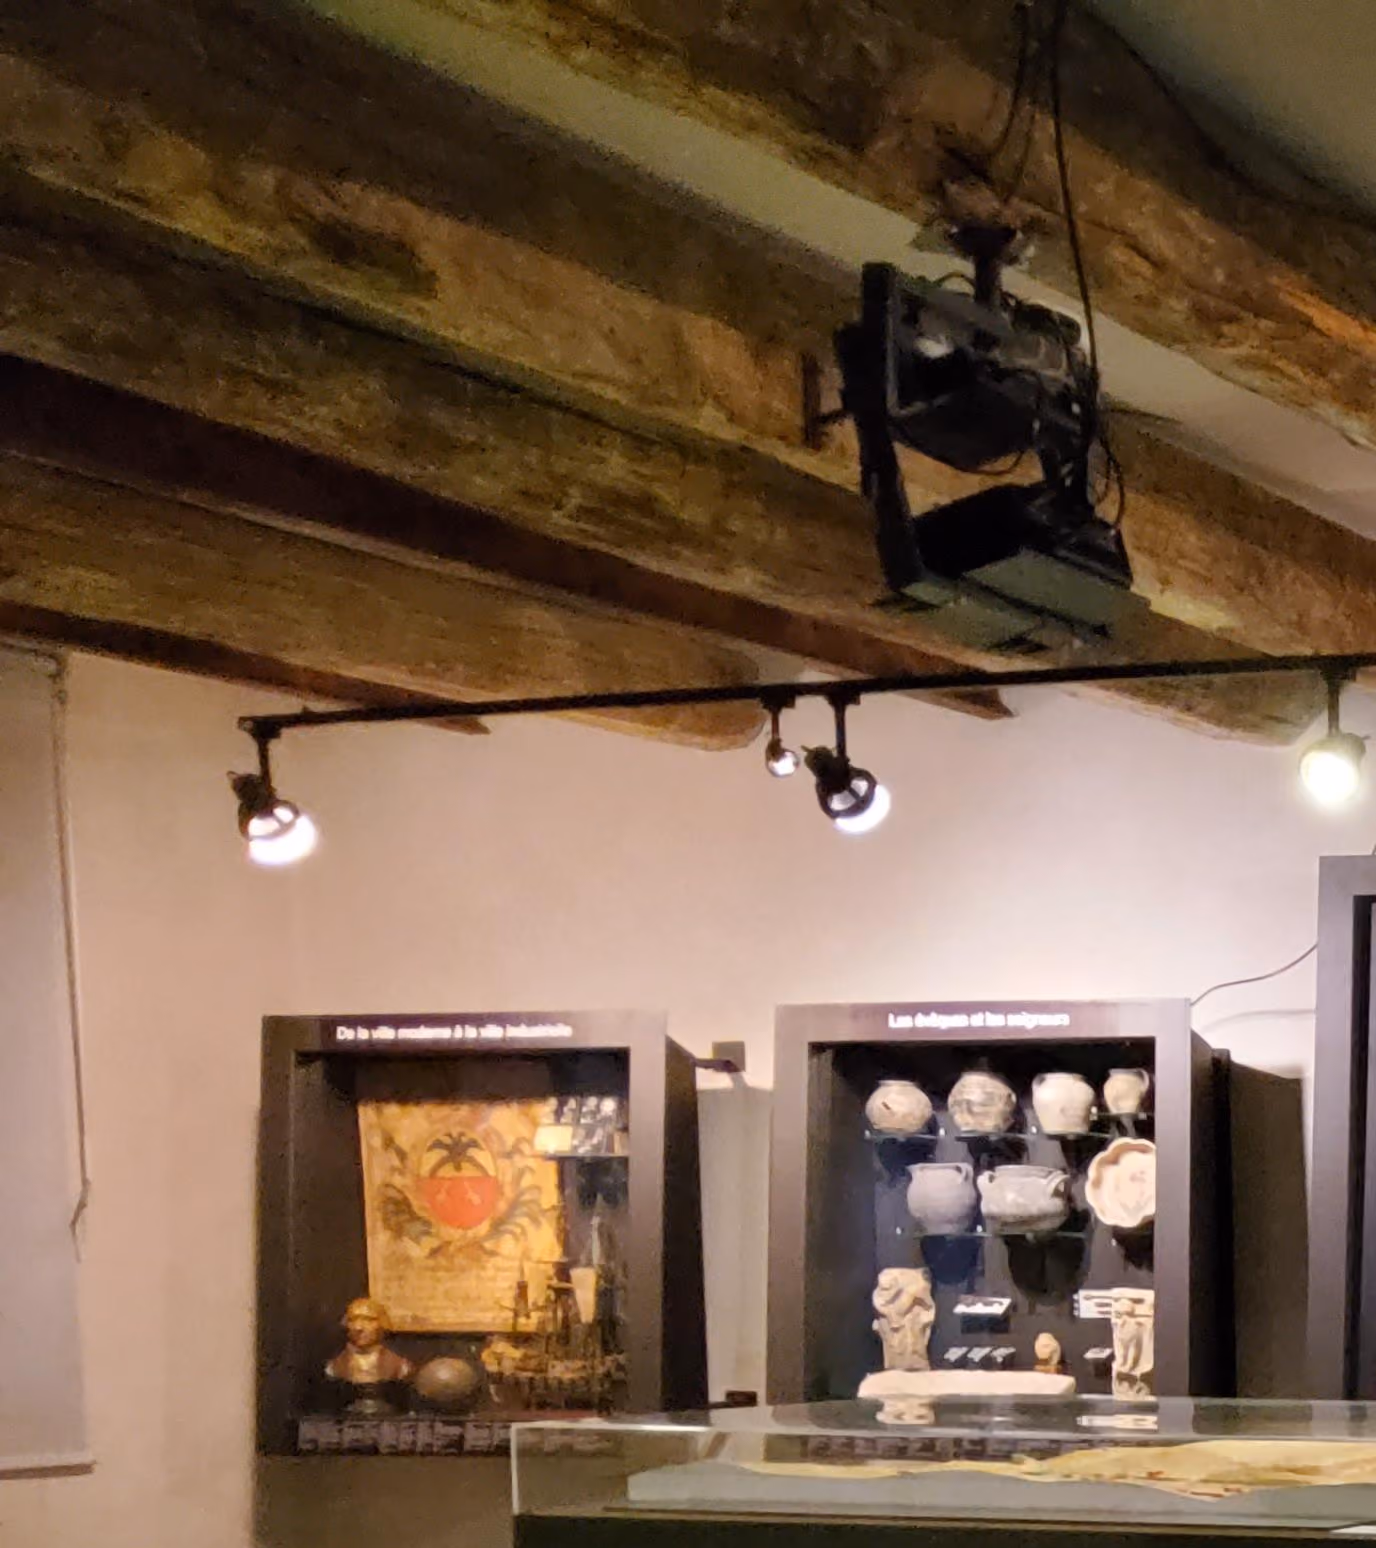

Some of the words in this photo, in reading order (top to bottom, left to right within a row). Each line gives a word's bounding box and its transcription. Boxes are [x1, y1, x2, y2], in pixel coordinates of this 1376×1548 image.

[888, 1012, 913, 1028] Les
[970, 1011, 984, 1027] et
[985, 1011, 1005, 1027] les
[336, 1026, 355, 1039] De
[356, 1025, 369, 1039] la
[371, 1025, 395, 1039] ville
[464, 1024, 477, 1038] la
